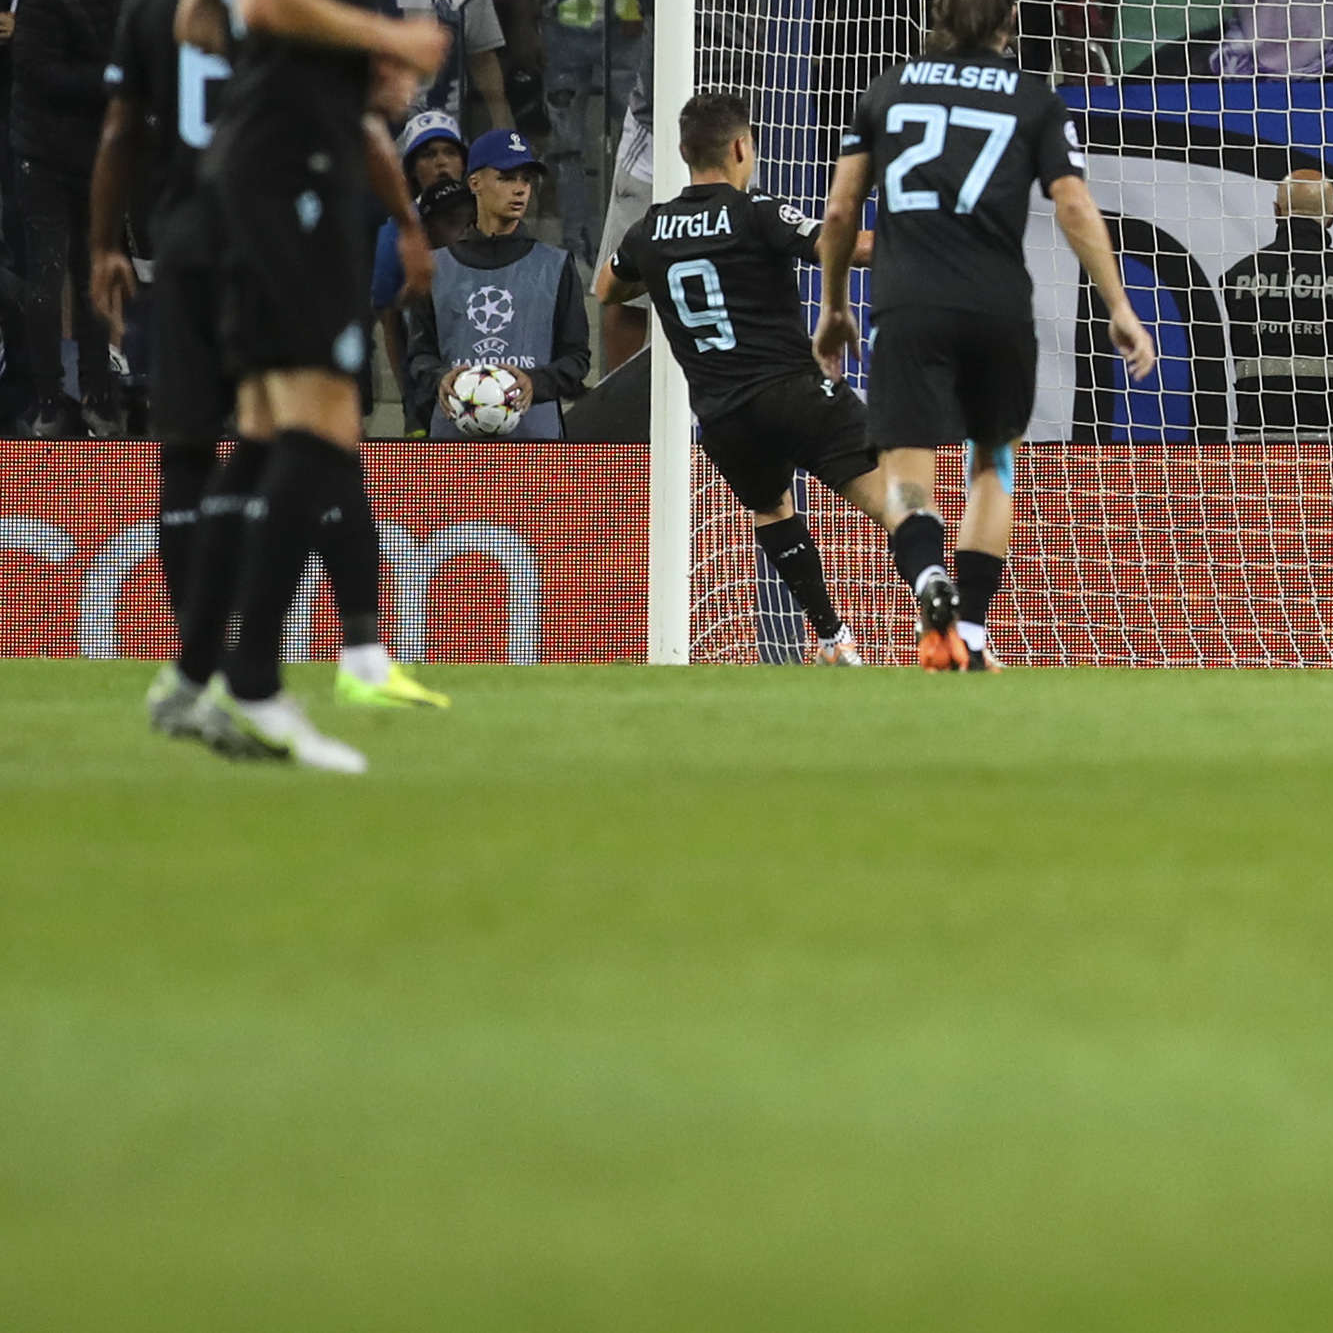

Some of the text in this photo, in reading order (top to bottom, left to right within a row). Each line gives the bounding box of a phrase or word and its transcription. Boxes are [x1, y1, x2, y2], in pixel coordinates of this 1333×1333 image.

[899, 61, 1019, 96] NIELSEN
[884, 103, 1018, 214] 27
[666, 257, 737, 355] 9
[474, 342, 506, 355] UEFA
